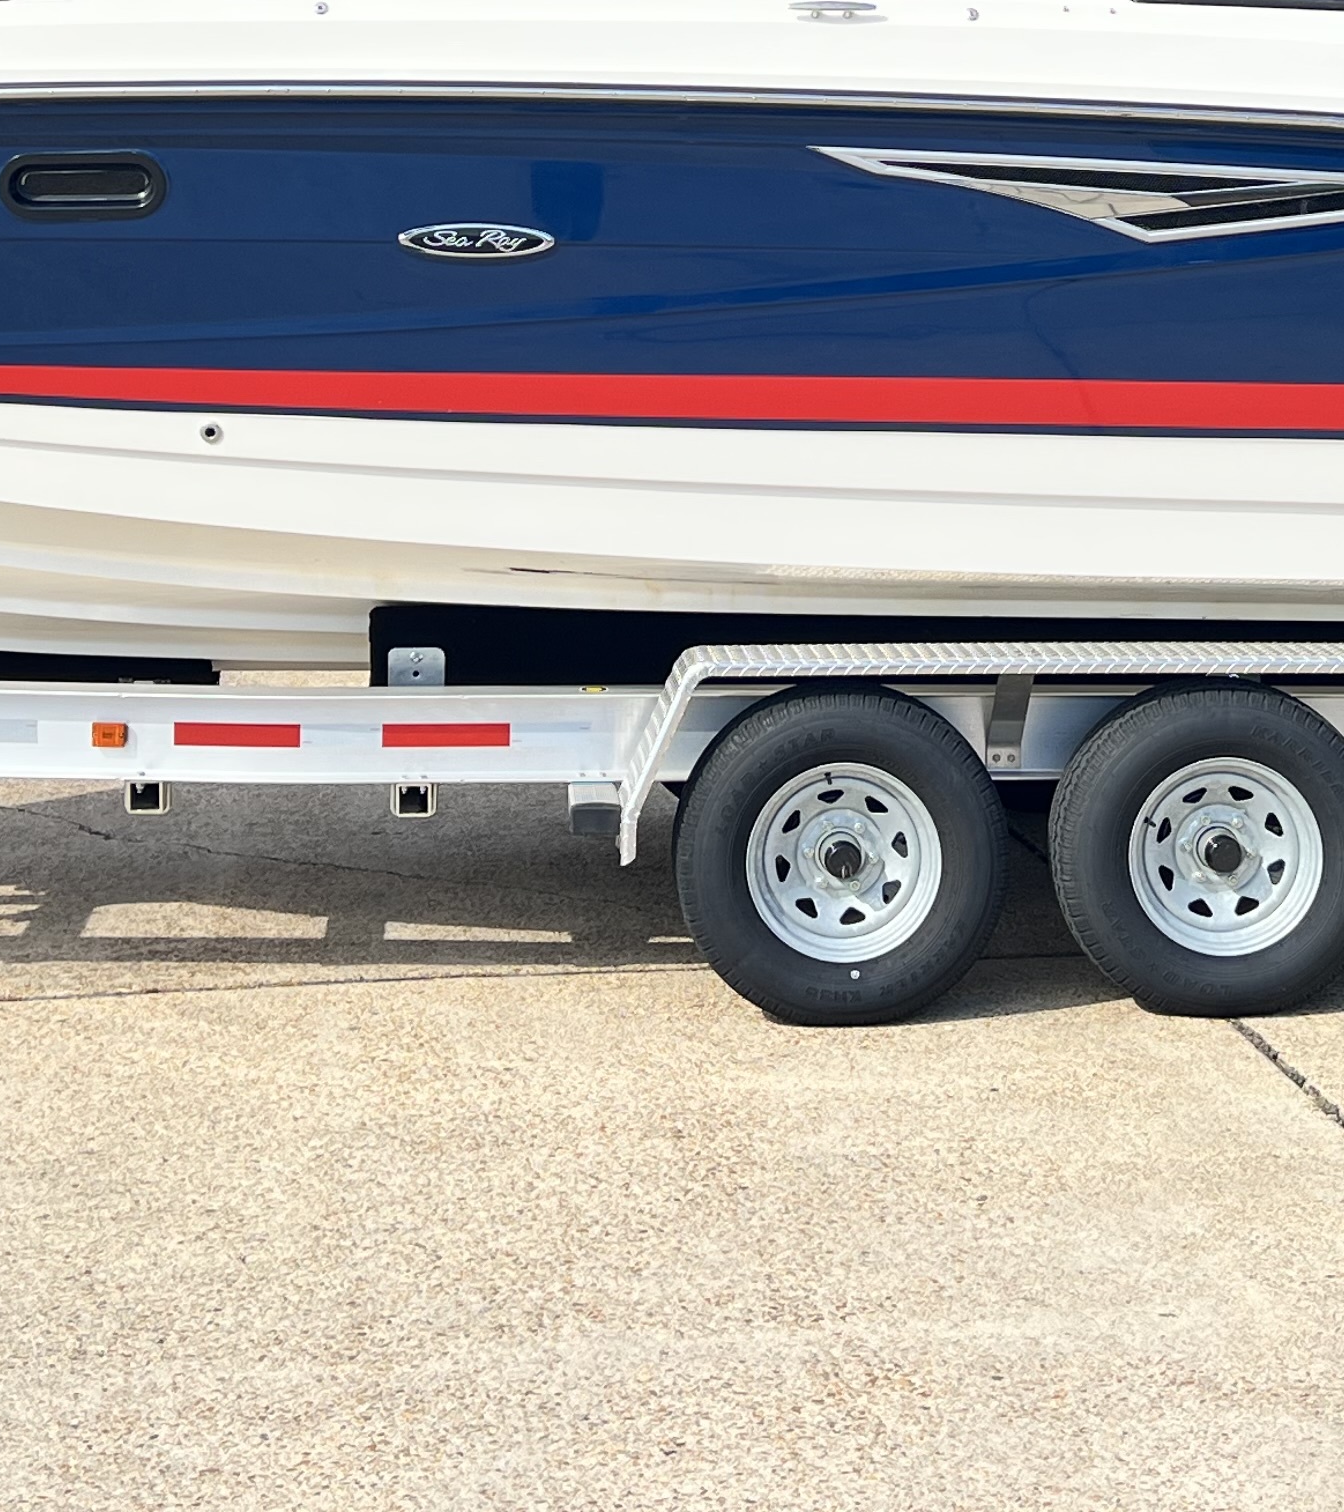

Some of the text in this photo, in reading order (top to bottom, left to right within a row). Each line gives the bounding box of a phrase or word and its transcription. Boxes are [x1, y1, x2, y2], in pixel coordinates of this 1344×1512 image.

[423, 229, 527, 252] Sea Ray
[768, 727, 836, 763] STAR
